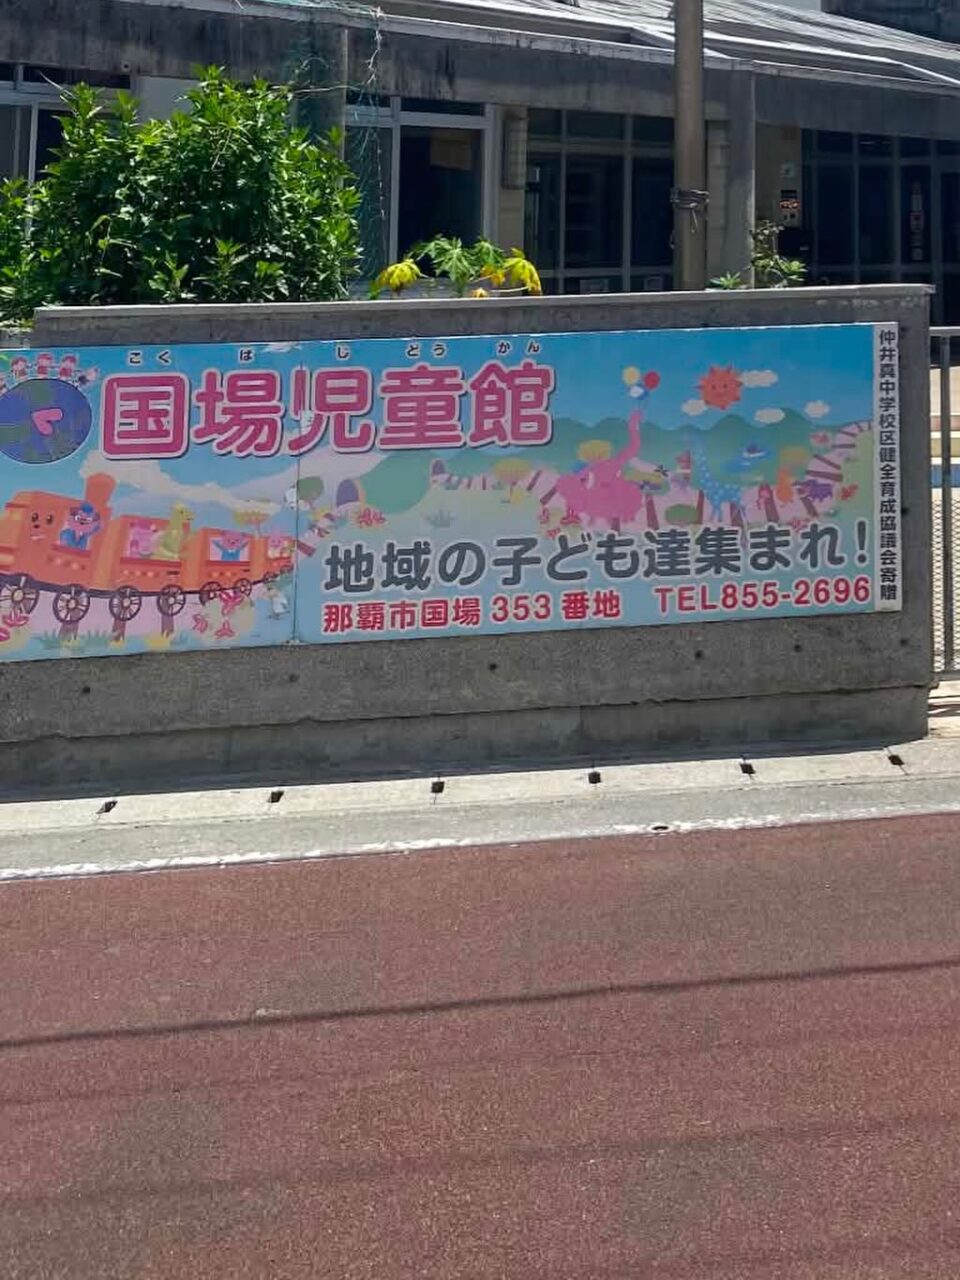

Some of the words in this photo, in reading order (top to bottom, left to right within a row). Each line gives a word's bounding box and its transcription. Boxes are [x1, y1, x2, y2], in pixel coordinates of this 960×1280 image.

[102, 360, 556, 458] 国場児童館
[323, 520, 869, 593] 地域の子ども達集まれ！
[654, 576, 871, 614] TEL855-2696
